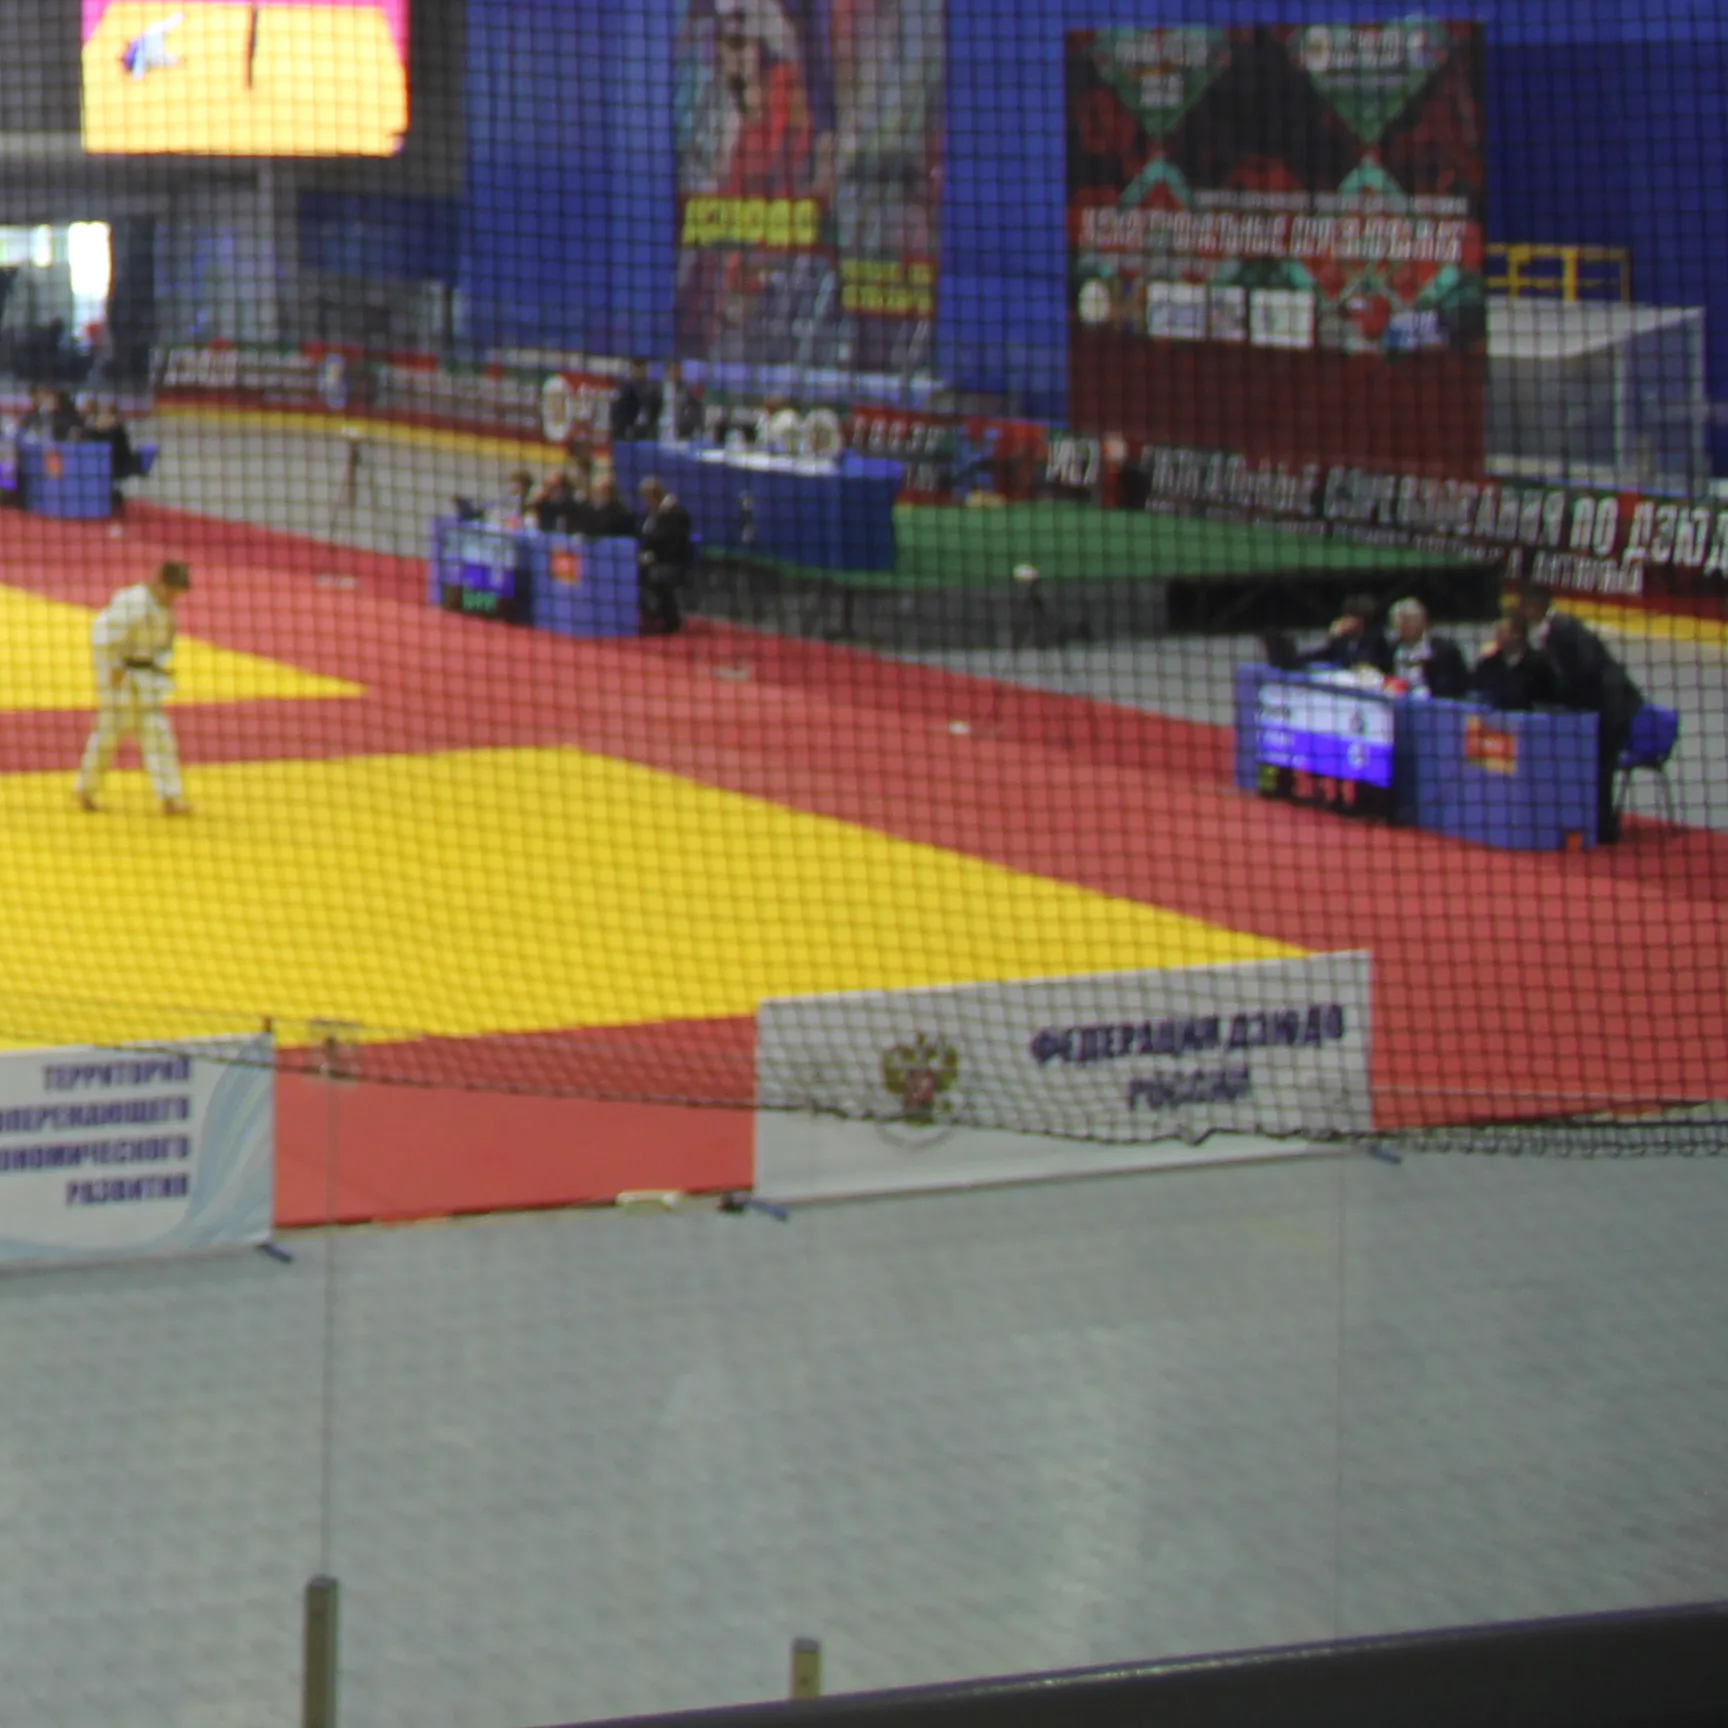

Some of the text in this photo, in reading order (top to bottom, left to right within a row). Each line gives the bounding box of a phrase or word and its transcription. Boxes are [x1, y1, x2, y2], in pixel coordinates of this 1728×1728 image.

[1569, 496, 1619, 556] ПО
[1226, 1003, 1343, 1050] ДЗЮДО
[43, 1055, 191, 1090] ТЕРРИТОРИЯ
[66, 1173, 189, 1208] РАЗВИТИЯ
